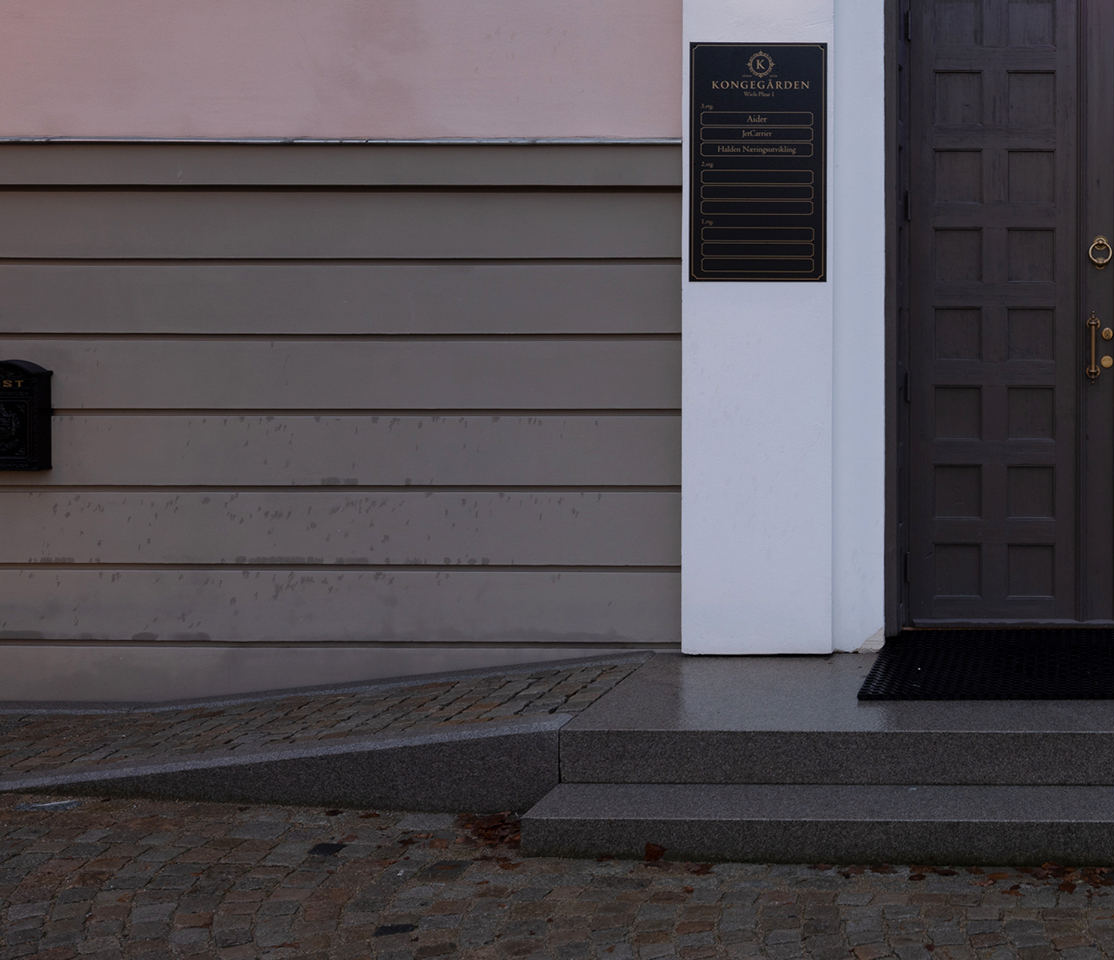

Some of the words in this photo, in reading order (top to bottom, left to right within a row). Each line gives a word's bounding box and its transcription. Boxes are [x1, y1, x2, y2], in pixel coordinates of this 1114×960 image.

[756, 59, 766, 70] K
[711, 78, 810, 90] KONGEGÅRDEN
[746, 115, 768, 123] Aider
[741, 129, 773, 138] JetCarrier
[717, 145, 741, 153] Halden
[742, 145, 797, 155] Næringsutvikling
[0, 379, 24, 388] ST
